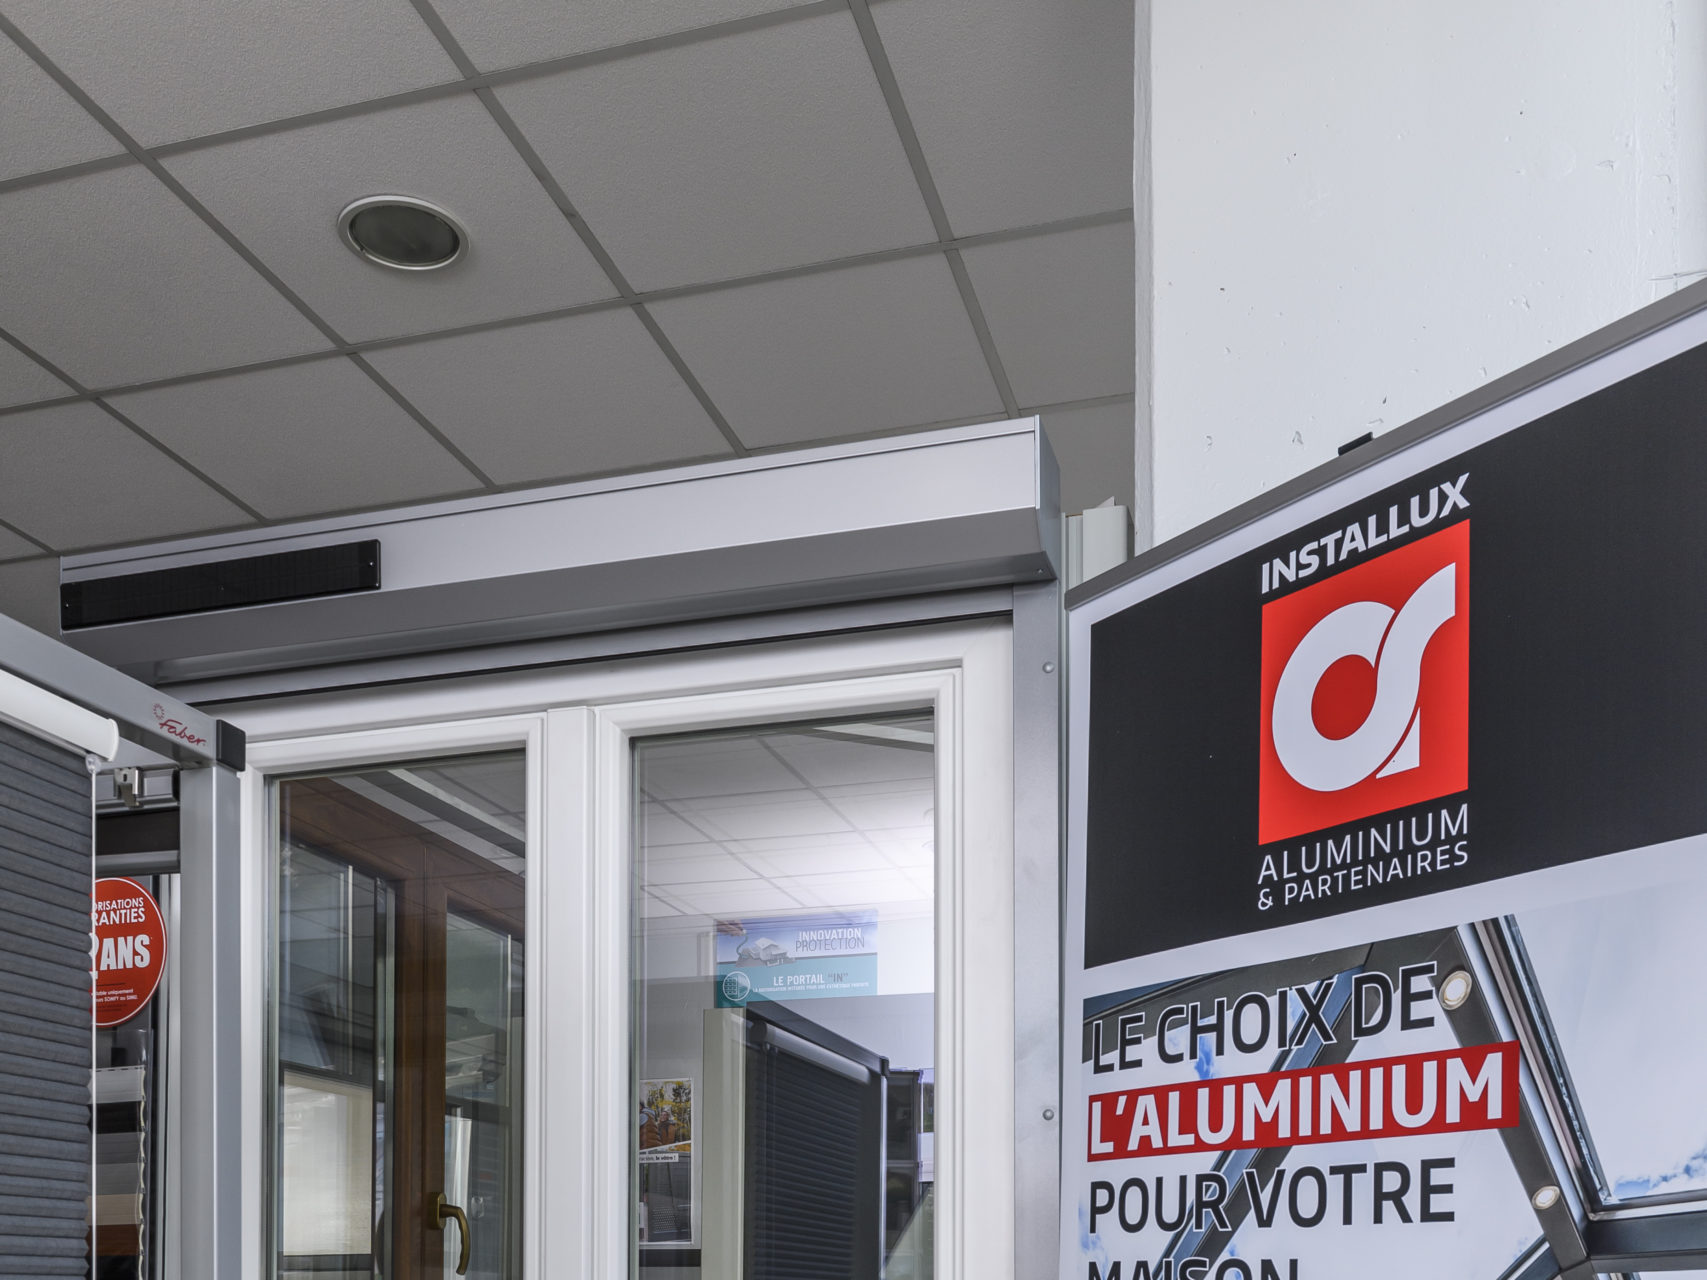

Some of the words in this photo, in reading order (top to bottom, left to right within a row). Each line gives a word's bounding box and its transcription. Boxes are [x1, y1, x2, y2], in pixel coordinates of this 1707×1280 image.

[1261, 472, 1471, 594] INSTALLUX
[159, 719, 207, 745] Faber
[1258, 803, 1469, 885] ALUMINIUM
[1258, 888, 1274, 911] &
[1284, 841, 1469, 905] PARTENAIRES
[795, 937, 865, 952] PROTECTION
[799, 928, 862, 941] INNOVATION
[773, 976, 783, 986] LE
[787, 973, 825, 985] PORTAIL
[1092, 1012, 1145, 1074] LE
[1156, 979, 1336, 1064] CHOIX
[1352, 961, 1437, 1040] DE
[1090, 1051, 1503, 1155] L'ALUMINIUM
[1089, 1170, 1231, 1234] POUR
[1243, 1157, 1456, 1230] VOTRE
